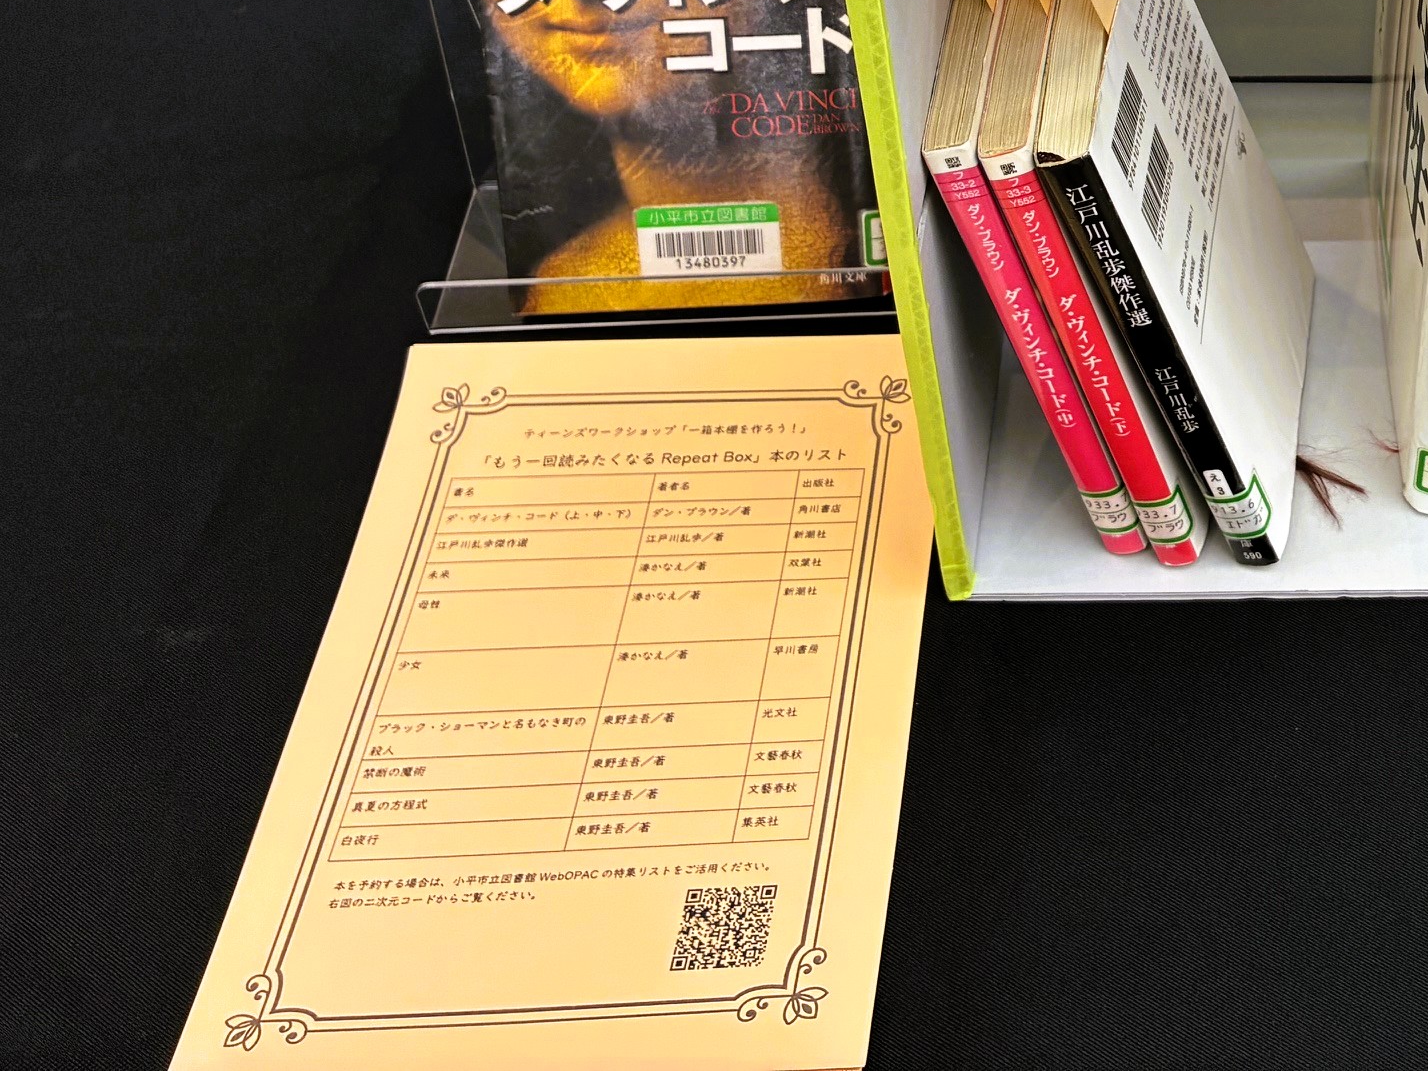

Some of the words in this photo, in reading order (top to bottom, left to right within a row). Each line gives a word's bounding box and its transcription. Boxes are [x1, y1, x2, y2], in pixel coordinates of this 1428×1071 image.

[662, 6, 853, 76] コード
[774, 87, 858, 112] VINCI
[731, 115, 812, 139] CODE
[951, 180, 976, 191] 33-2
[1006, 186, 1032, 198] 33-3
[648, 206, 768, 226] 小平市立図書館
[968, 203, 1005, 271] ダン・ブラウン
[1023, 210, 1059, 278] ダン・ブラウン
[676, 255, 747, 270] 13480397
[1066, 184, 1152, 328] 江戸川乱歩傑作選
[1154, 366, 1200, 434] 江戸川乱歩
[661, 452, 718, 467] Repeat
[769, 449, 847, 462] 本のリスト
[1217, 486, 1226, 496] 3
[762, 706, 798, 719] 光文社
[539, 869, 599, 882] WebOPAC
